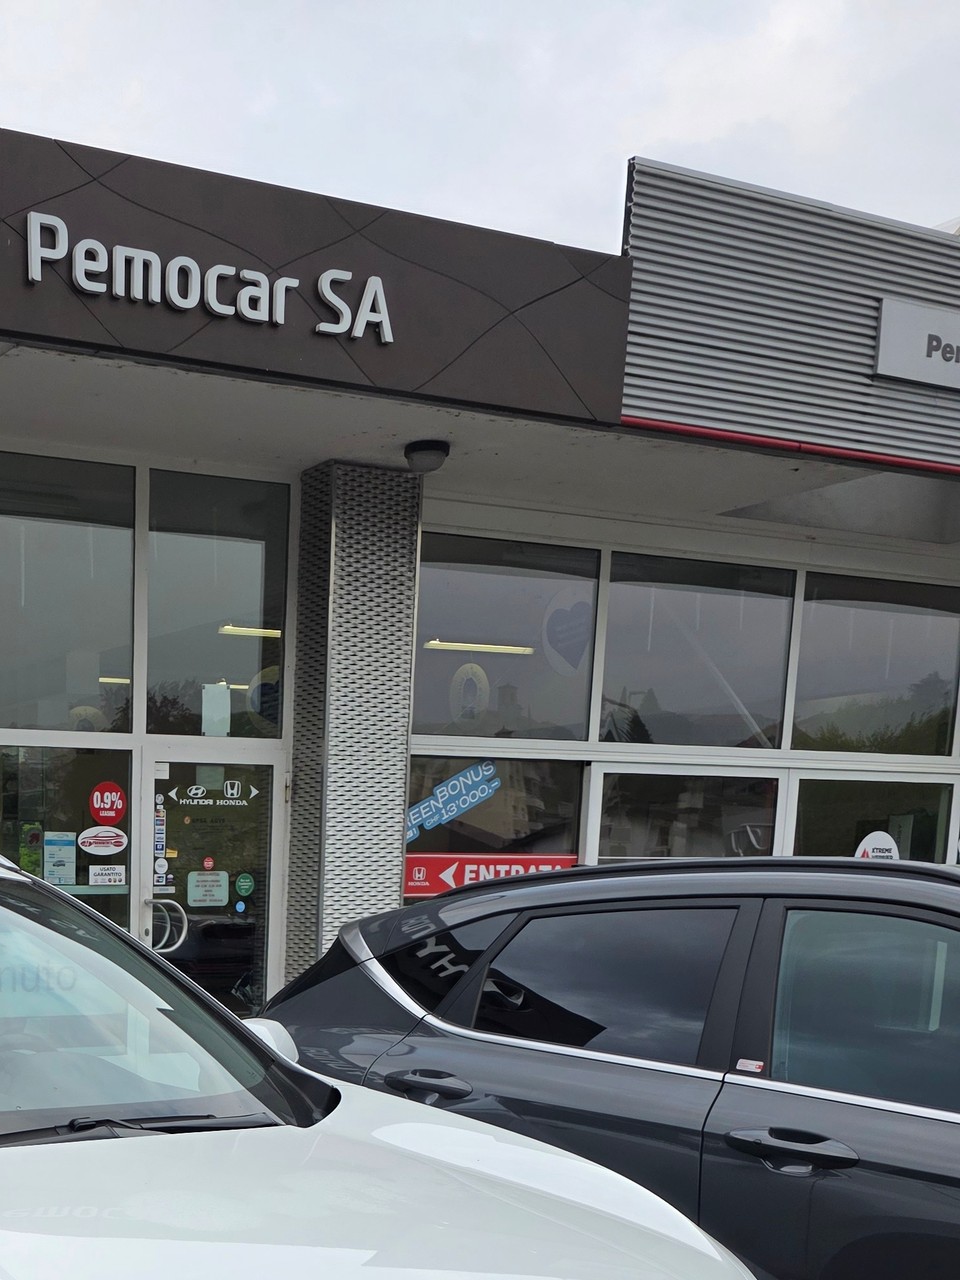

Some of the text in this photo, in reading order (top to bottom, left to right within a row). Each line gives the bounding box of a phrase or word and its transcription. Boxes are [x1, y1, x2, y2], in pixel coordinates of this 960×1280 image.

[26, 210, 395, 344] Pemocar SA
[93, 791, 123, 809] 0.9%
[436, 760, 495, 801] BONUS
